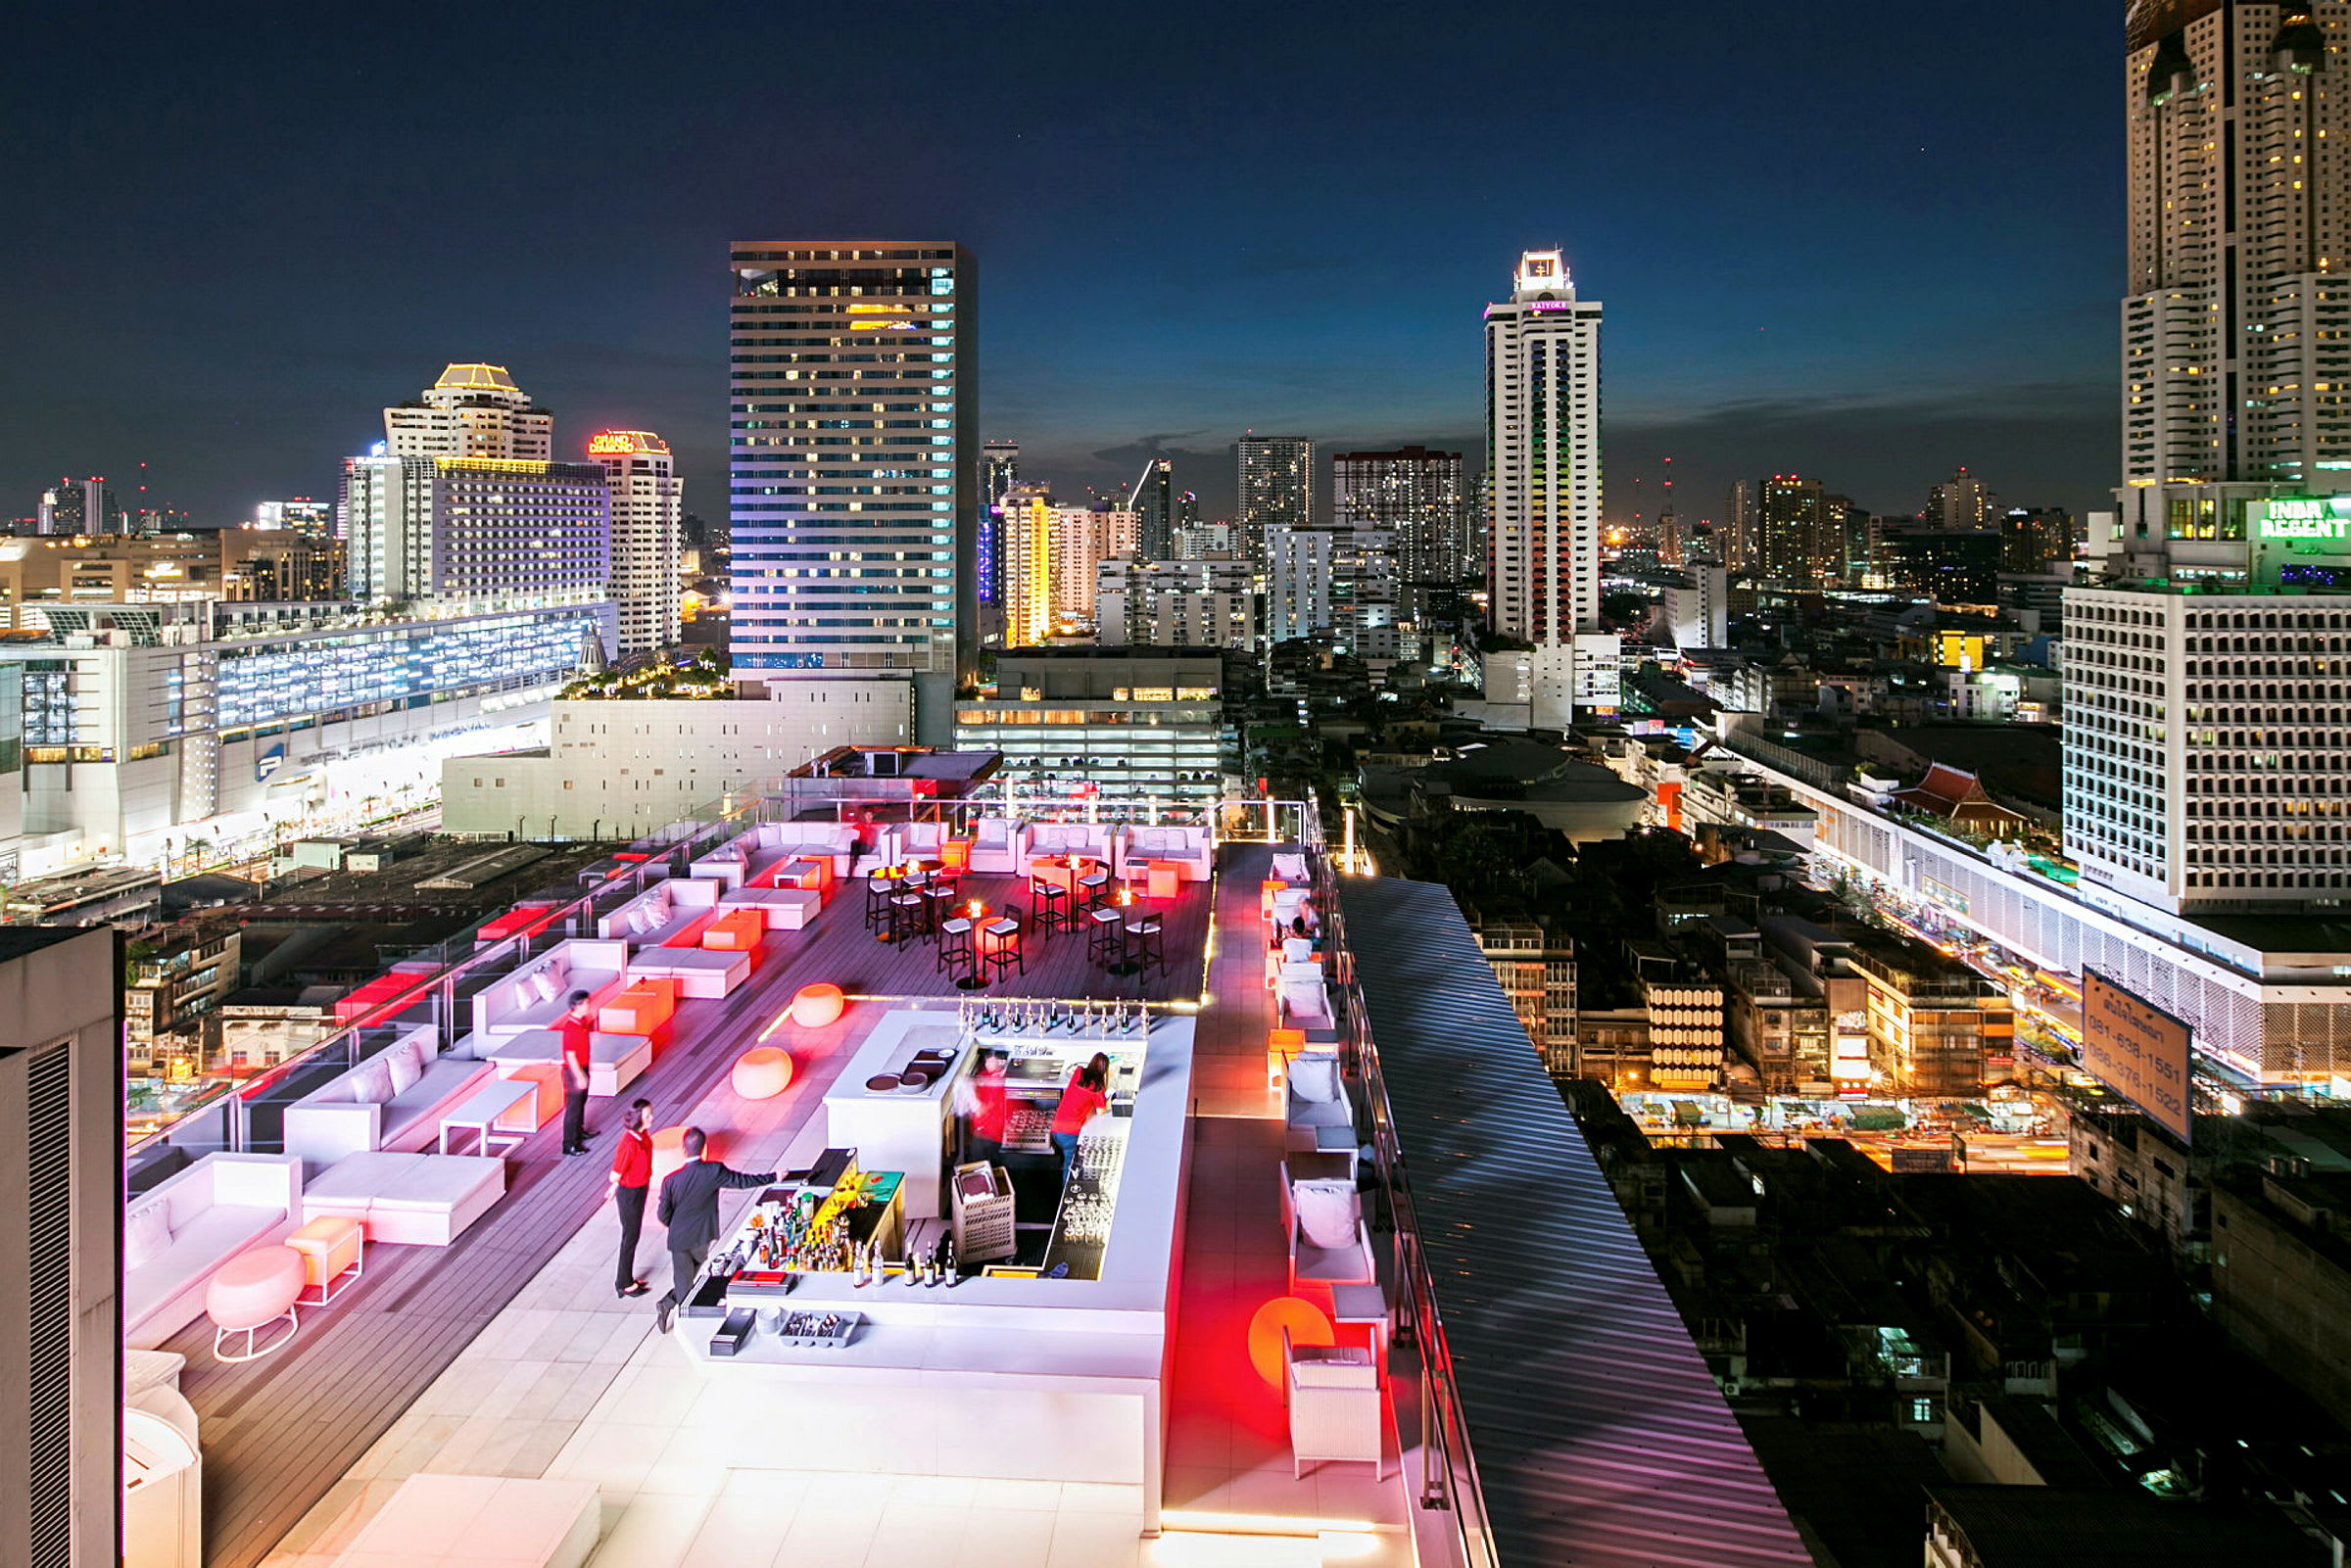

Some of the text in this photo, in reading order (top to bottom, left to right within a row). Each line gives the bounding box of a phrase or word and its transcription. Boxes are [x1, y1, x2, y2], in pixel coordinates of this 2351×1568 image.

[593, 434, 629, 444] GRAND
[589, 443, 634, 453] DIAMOND
[2260, 519, 2349, 538] REGENT
